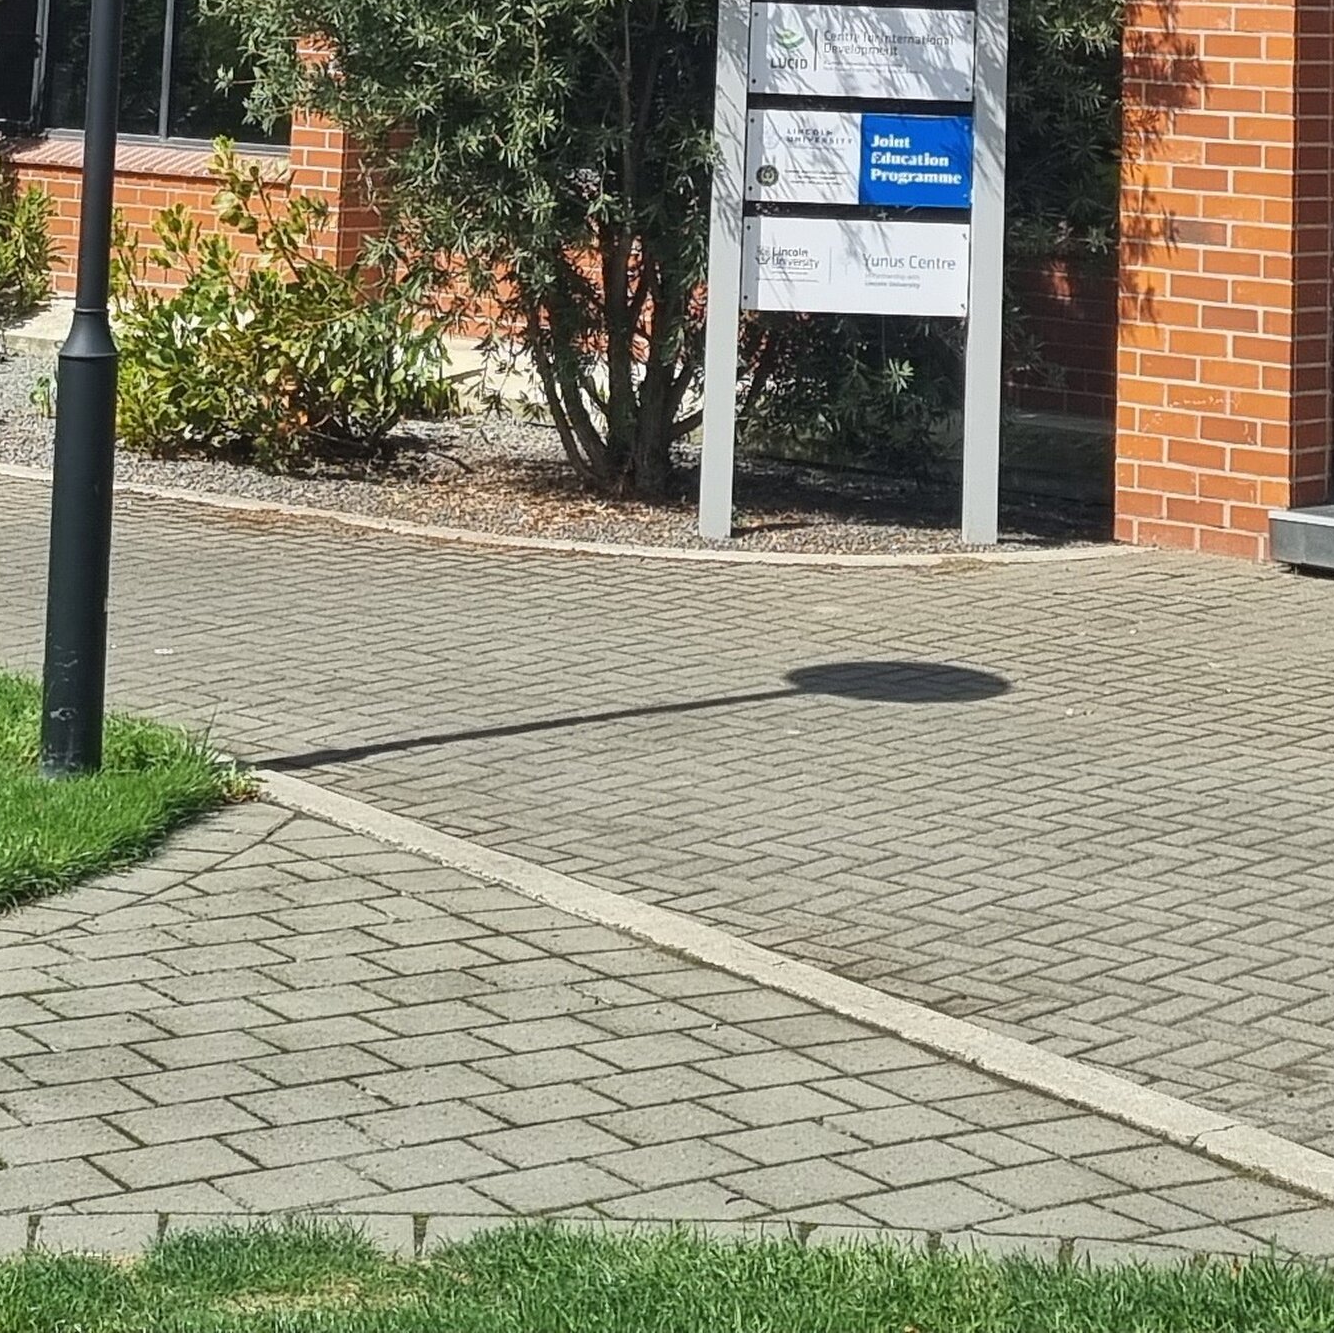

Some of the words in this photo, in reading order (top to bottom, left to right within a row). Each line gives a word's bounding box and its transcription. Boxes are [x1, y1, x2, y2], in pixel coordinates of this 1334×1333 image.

[770, 58, 808, 71] LUCID
[871, 135, 911, 149] Joint
[870, 151, 950, 168] Education
[870, 168, 963, 186] Programme
[772, 246, 809, 257] Lincoln
[862, 253, 905, 269] Yunus
[908, 255, 956, 270] Centre
